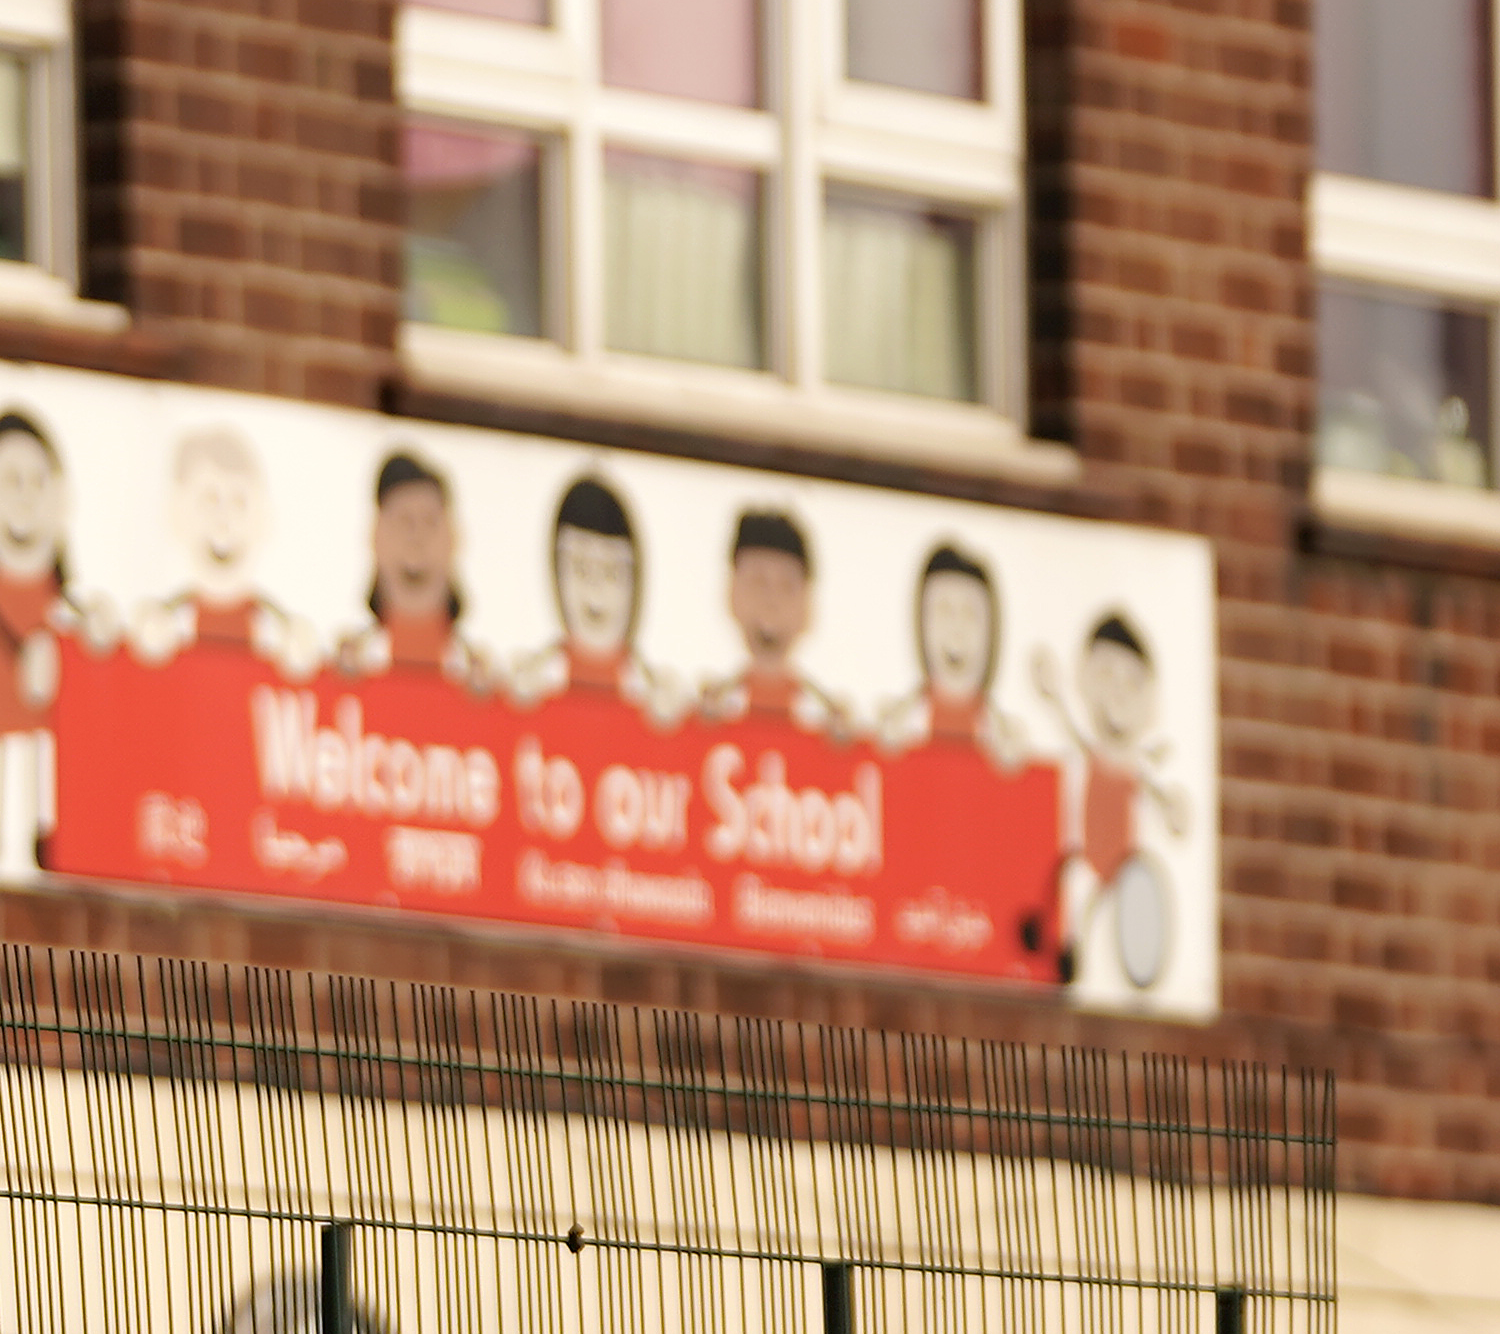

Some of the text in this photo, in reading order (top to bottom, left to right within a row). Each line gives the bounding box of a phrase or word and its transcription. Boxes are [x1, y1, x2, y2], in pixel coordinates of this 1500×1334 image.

[250, 684, 500, 829] Welcome
[515, 734, 585, 841] to
[595, 763, 692, 854] our
[702, 742, 885, 876] School
